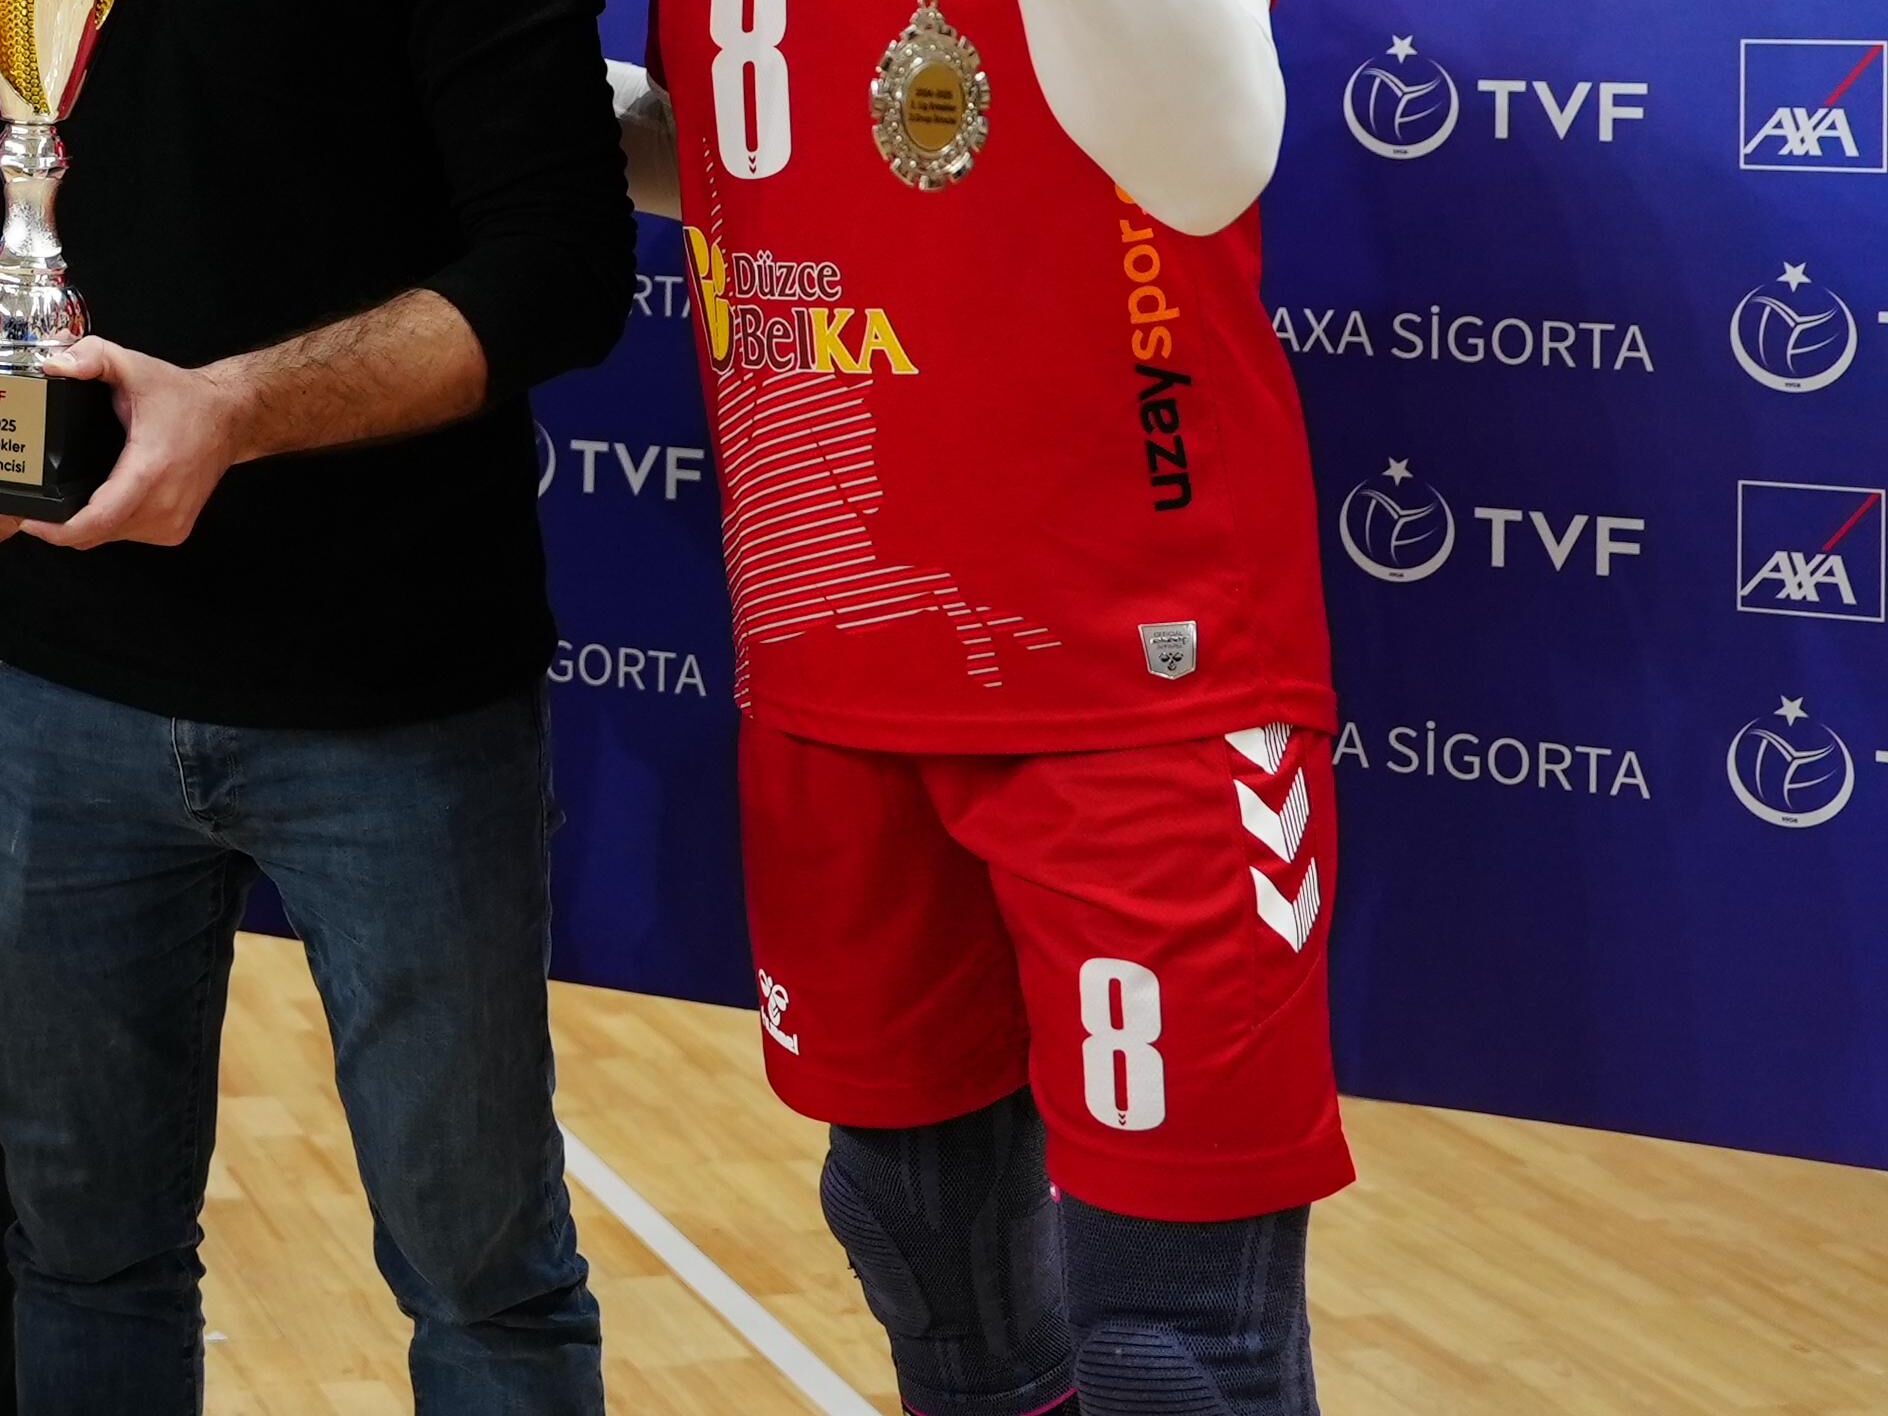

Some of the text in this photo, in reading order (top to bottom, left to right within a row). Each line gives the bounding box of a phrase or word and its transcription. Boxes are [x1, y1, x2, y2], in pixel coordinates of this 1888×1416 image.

[1477, 79, 1648, 142] TVF
[1743, 106, 1860, 157] AXA
[730, 249, 842, 300] Düzce
[734, 304, 920, 376] BelKA
[1272, 305, 1655, 374] AXA SİGORTA
[570, 439, 705, 501] TVF
[1474, 507, 1645, 577] TVF
[1739, 550, 1858, 606] AXA
[547, 639, 707, 697] GORTA
[1385, 720, 1651, 800] SİGORTA
[1079, 957, 1166, 1131] 8
